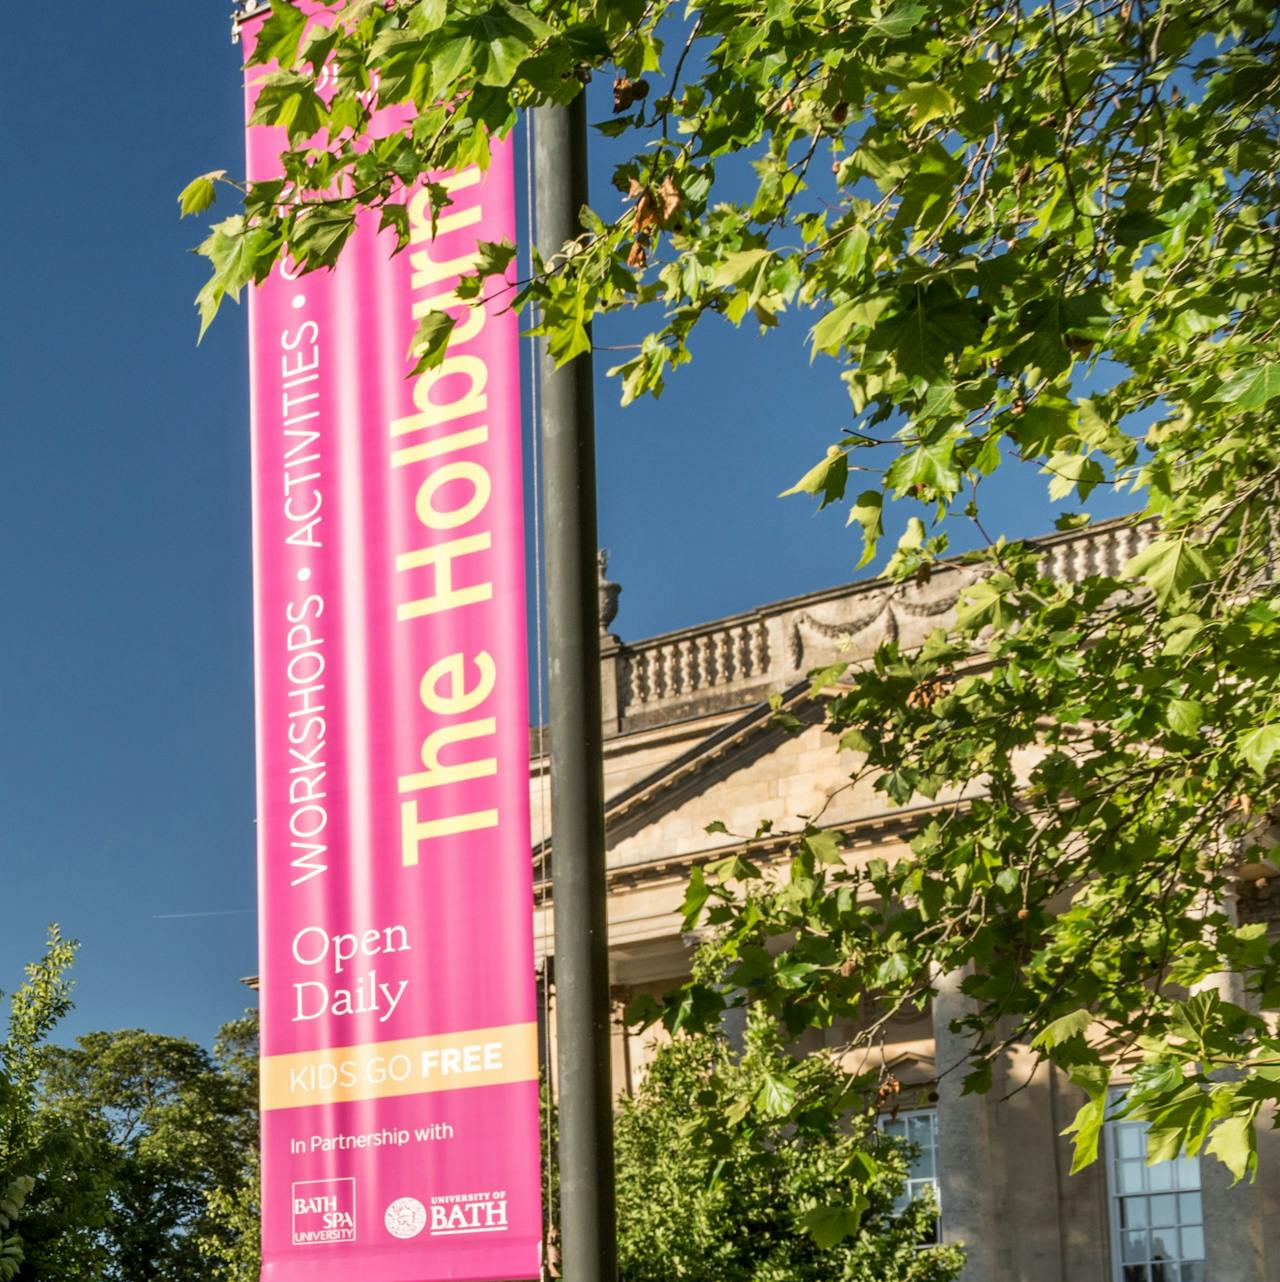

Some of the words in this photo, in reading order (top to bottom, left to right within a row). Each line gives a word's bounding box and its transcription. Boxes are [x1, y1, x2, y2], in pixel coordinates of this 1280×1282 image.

[389, 166, 493, 622] Holburn
[281, 320, 321, 549] ACTIVITIES
[287, 593, 327, 886] WORKSHOPS
[397, 650, 499, 867] The
[292, 923, 411, 973] Open
[291, 970, 409, 1022] Daily
[289, 1060, 357, 1094] KIDS
[366, 1054, 412, 1084] GO
[421, 1042, 503, 1077] FREE
[290, 1138, 307, 1155] In
[310, 1127, 410, 1151] Partnership
[414, 1123, 454, 1142] with
[294, 1195, 337, 1215] BATH
[322, 1211, 354, 1229] SPA
[430, 1200, 508, 1231] BATH
[431, 1191, 490, 1205] UNIVERSITY
[492, 1190, 506, 1201] OF
[294, 1228, 354, 1242] UNIVERSITY
